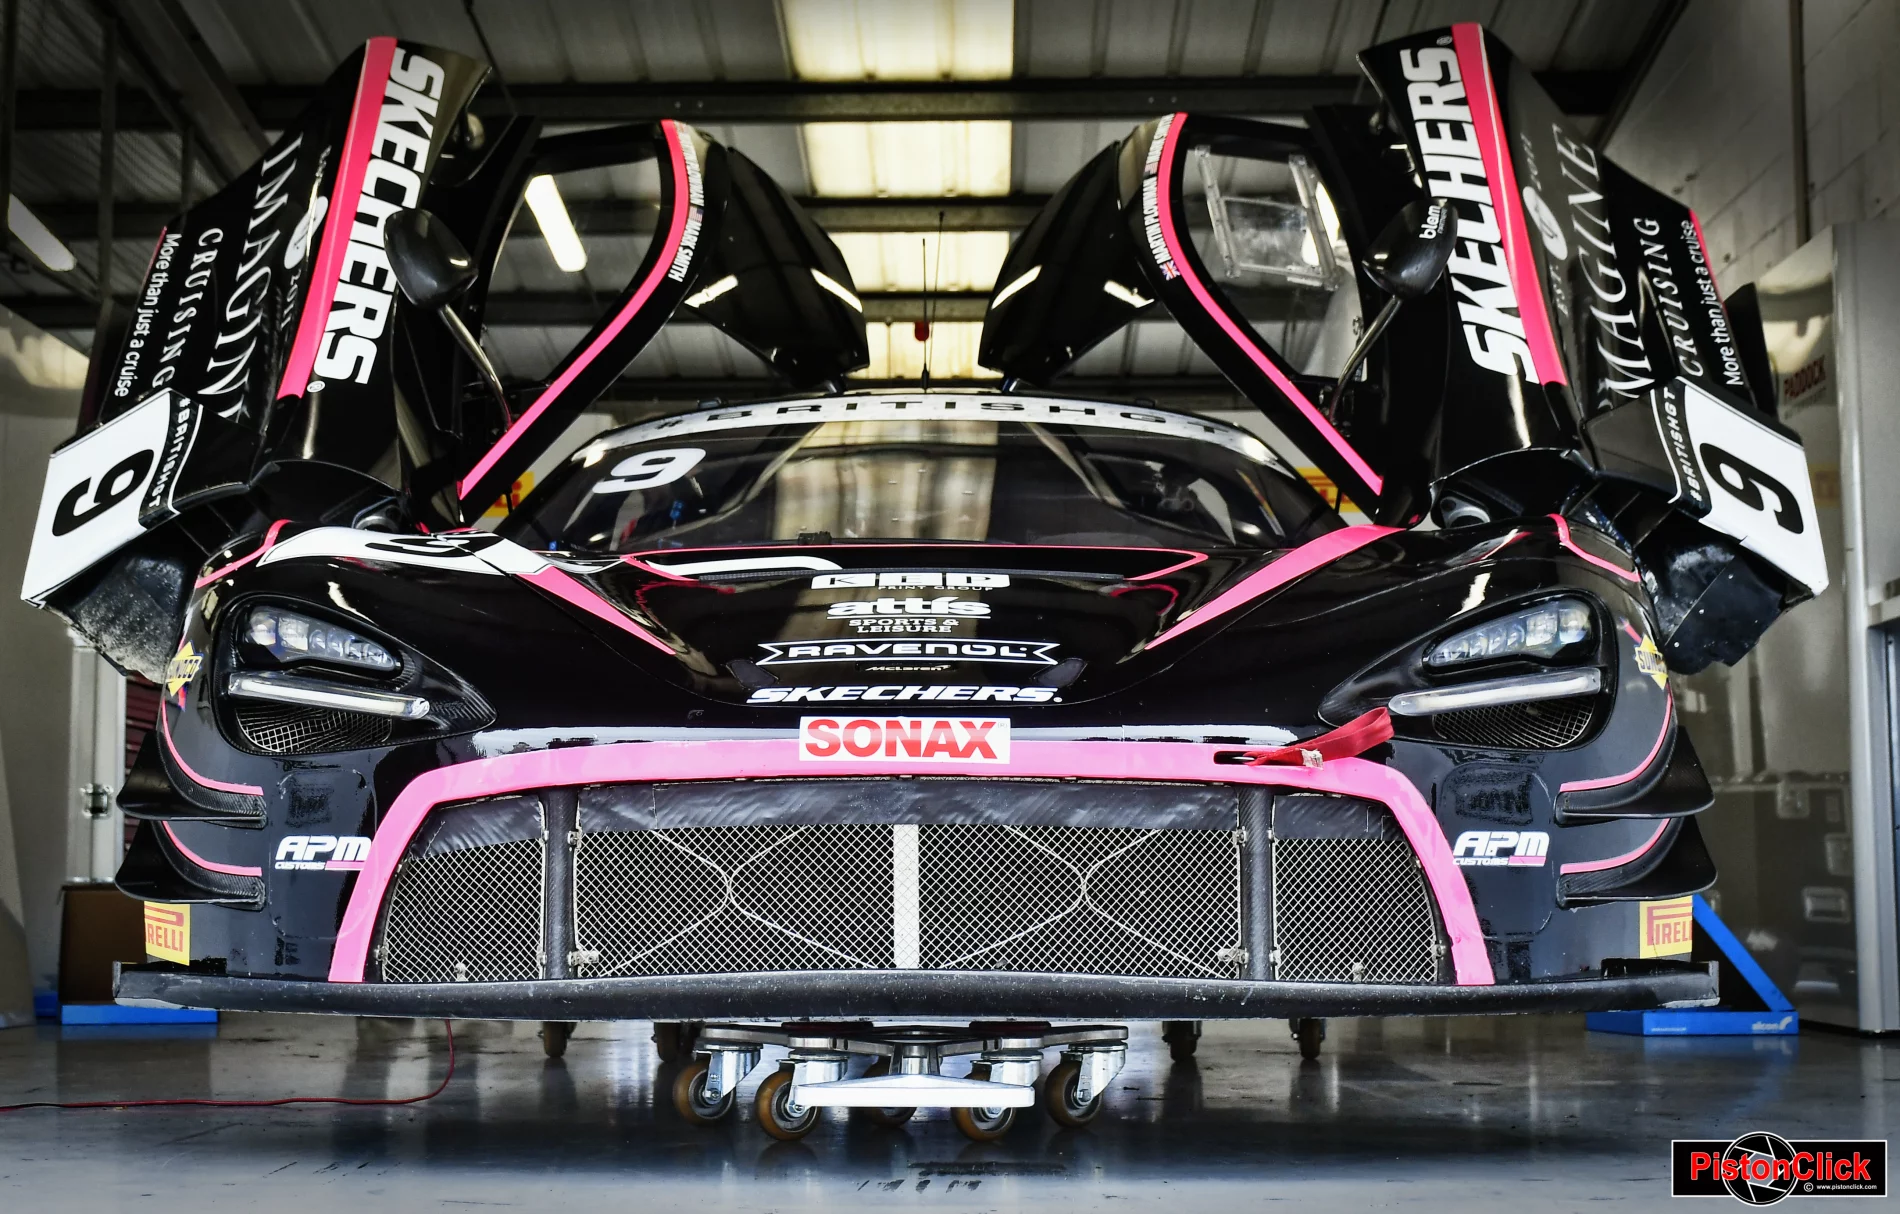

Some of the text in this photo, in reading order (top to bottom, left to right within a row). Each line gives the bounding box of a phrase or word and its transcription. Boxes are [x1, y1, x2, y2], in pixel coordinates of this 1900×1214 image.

[668, 222, 702, 282] MARK SMITH
[1143, 176, 1171, 264] MARTIN PLOWMAN
[114, 233, 182, 397] More than just a cruise
[152, 227, 223, 388] CRUISING
[1633, 217, 1704, 377] CRUISING
[1680, 219, 1744, 386] More than just a cruise
[594, 447, 707, 492] 9
[1664, 386, 1702, 502] #BRITISHGT
[52, 449, 154, 537] 9
[1699, 442, 1804, 535] 9
[827, 597, 991, 615] attis
[849, 618, 960, 626] SPORTS &
[857, 625, 952, 633] LEISURE
[805, 719, 997, 759] SONAX
[275, 836, 372, 861] APM
[1452, 831, 1550, 856] APM
